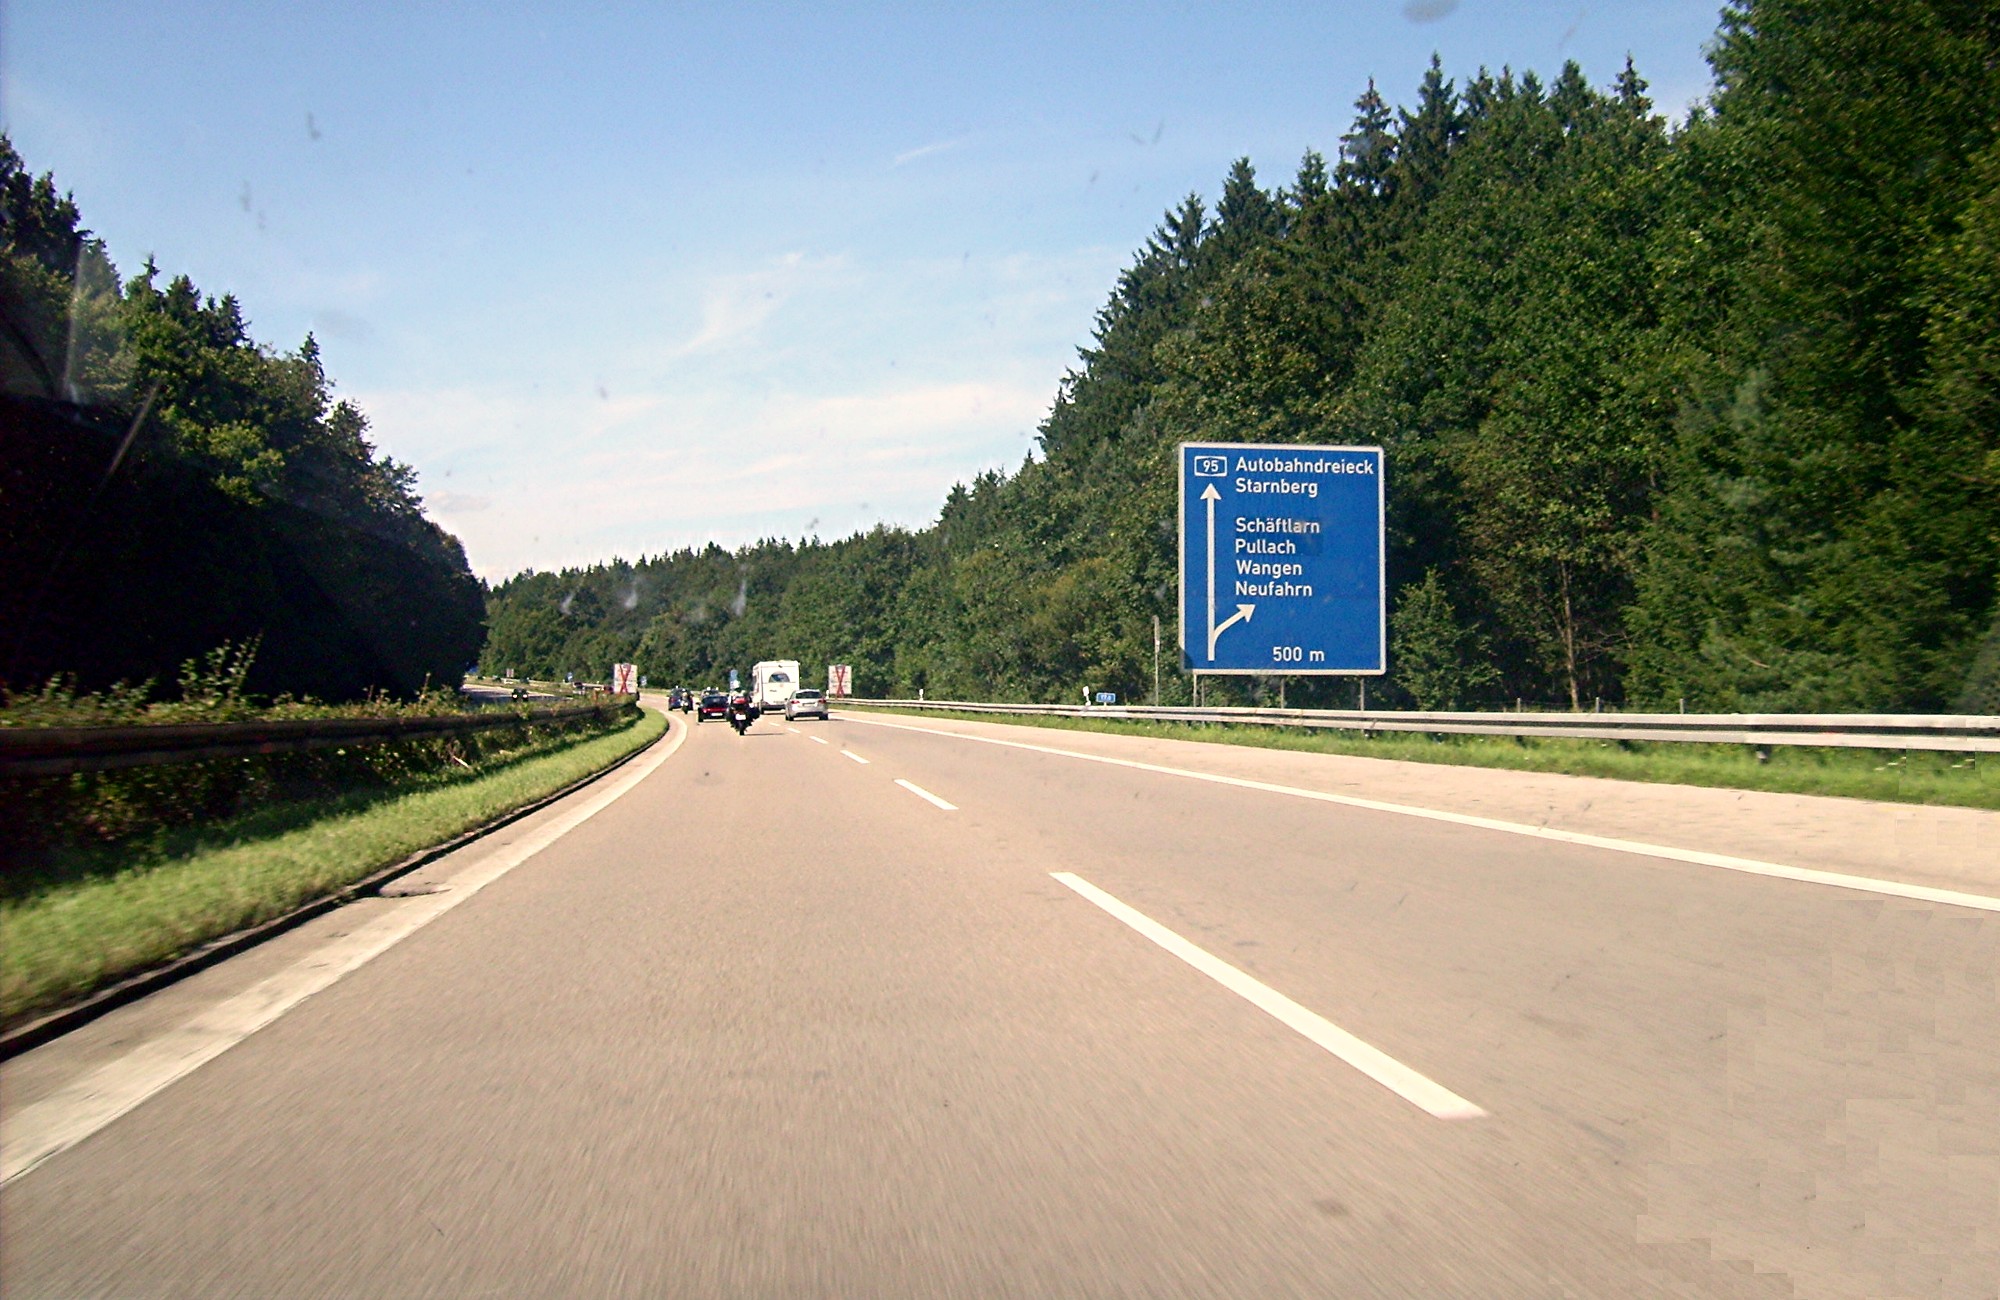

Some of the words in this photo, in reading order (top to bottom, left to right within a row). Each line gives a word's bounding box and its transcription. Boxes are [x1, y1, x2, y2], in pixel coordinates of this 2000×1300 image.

[1203, 460, 1219, 472] 95
[1236, 457, 1374, 475] Autobahndreieck
[1236, 478, 1318, 498] Starnberg
[1236, 517, 1320, 533] Schäftlarn
[1235, 539, 1296, 554] Pullach
[1236, 560, 1302, 578] Wangen
[1235, 581, 1312, 596] Neufahrn
[1272, 647, 1302, 662] 500
[1309, 650, 1325, 662] m
